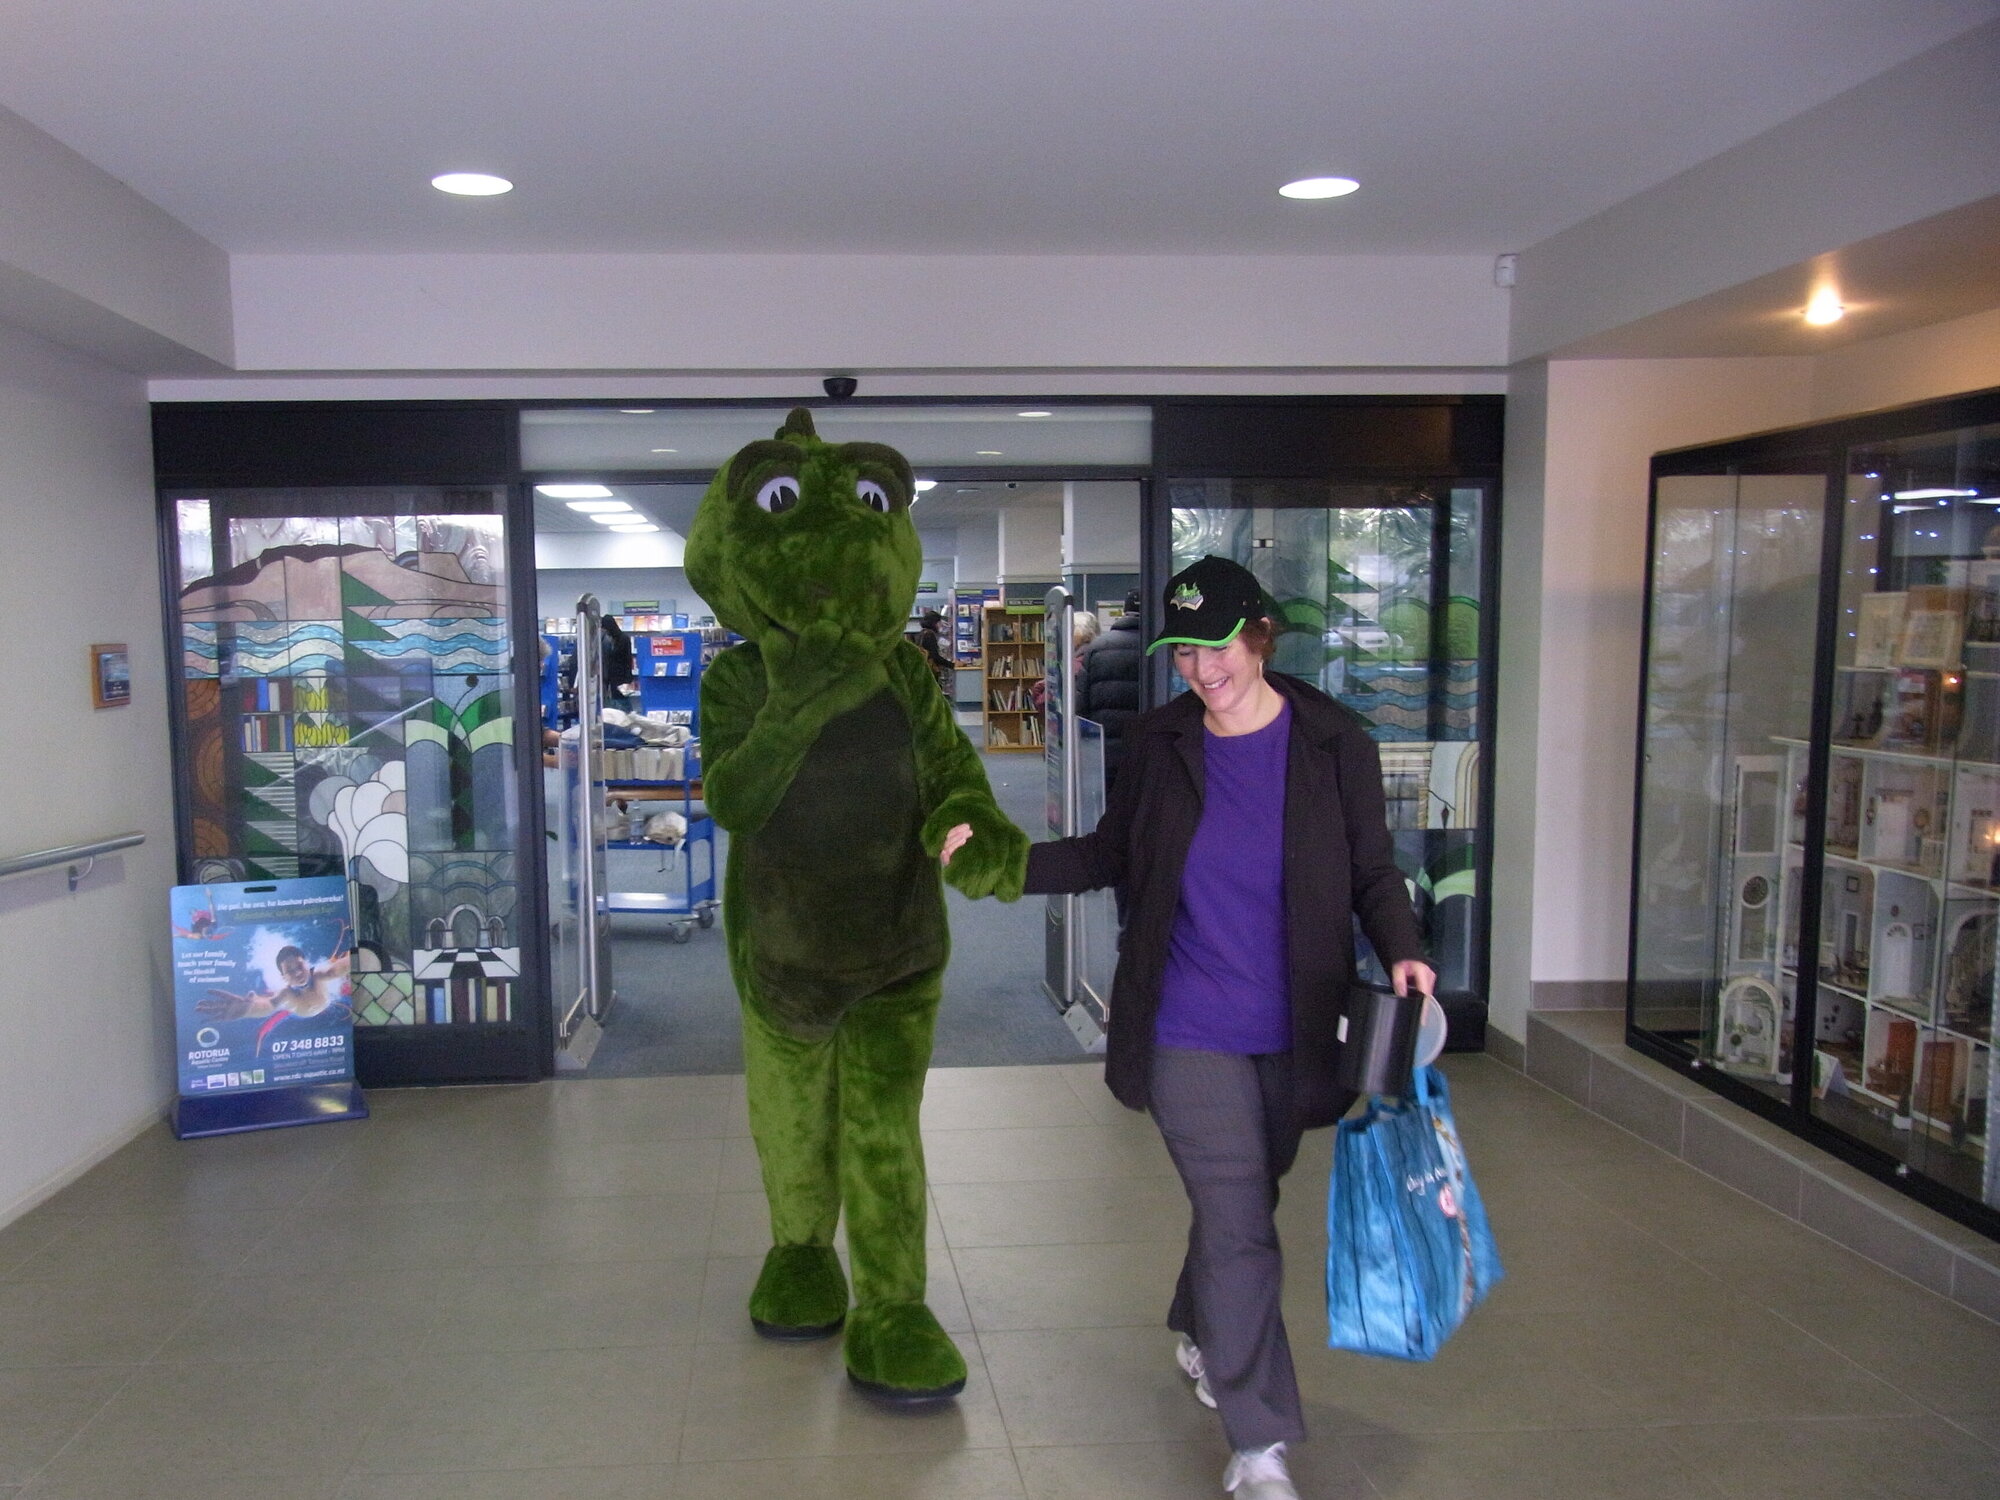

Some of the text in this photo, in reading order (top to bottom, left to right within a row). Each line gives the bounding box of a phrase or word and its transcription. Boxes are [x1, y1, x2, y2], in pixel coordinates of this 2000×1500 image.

[204, 950, 228, 959] family
[214, 959, 236, 968] family
[272, 1035, 344, 1053] 07 348 8833
[188, 1048, 231, 1060] ROTORUA
[273, 1052, 291, 1060] OPEN
